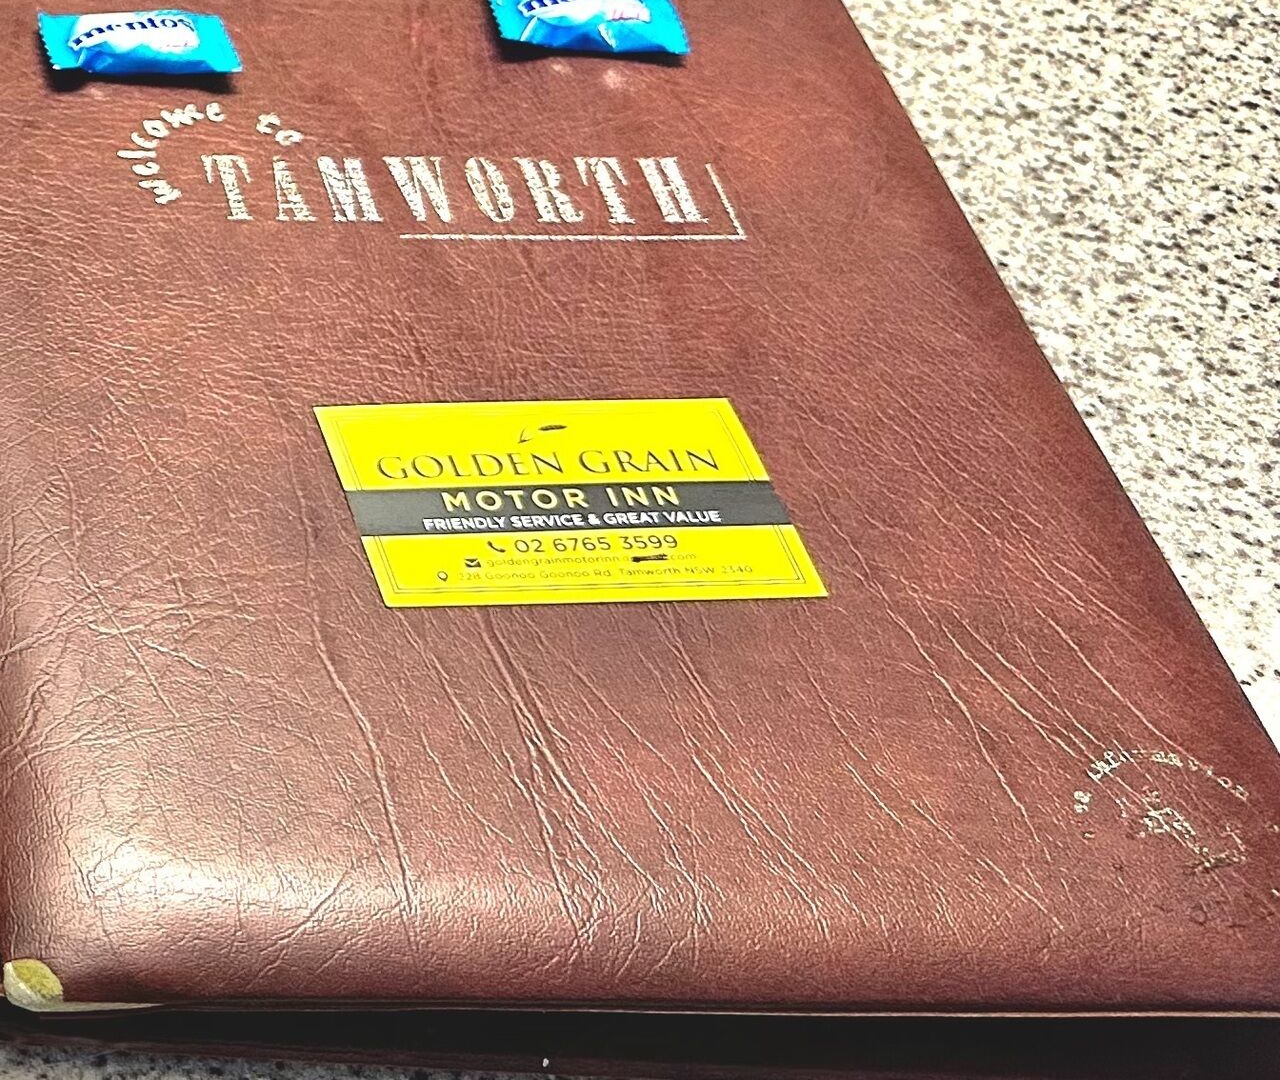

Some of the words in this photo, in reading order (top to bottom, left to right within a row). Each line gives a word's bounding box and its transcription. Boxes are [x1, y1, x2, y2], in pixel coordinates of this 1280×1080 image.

[117, 102, 227, 206] welcome
[256, 113, 305, 147] to
[199, 153, 710, 224] TAMWORTH
[376, 450, 563, 481] GOLDEN
[578, 447, 721, 475] GRAIN
[441, 489, 589, 513] MOTOR
[608, 485, 683, 507] INN
[423, 515, 507, 532] FRIENDLY
[510, 512, 586, 529] SERVICE
[587, 512, 601, 526] &
[604, 510, 661, 527] GREAT
[663, 509, 723, 525] VALUE
[514, 538, 546, 555] 02
[553, 536, 612, 554] 6765
[620, 533, 679, 552] 3599
[619, 566, 682, 577] Tamworth
